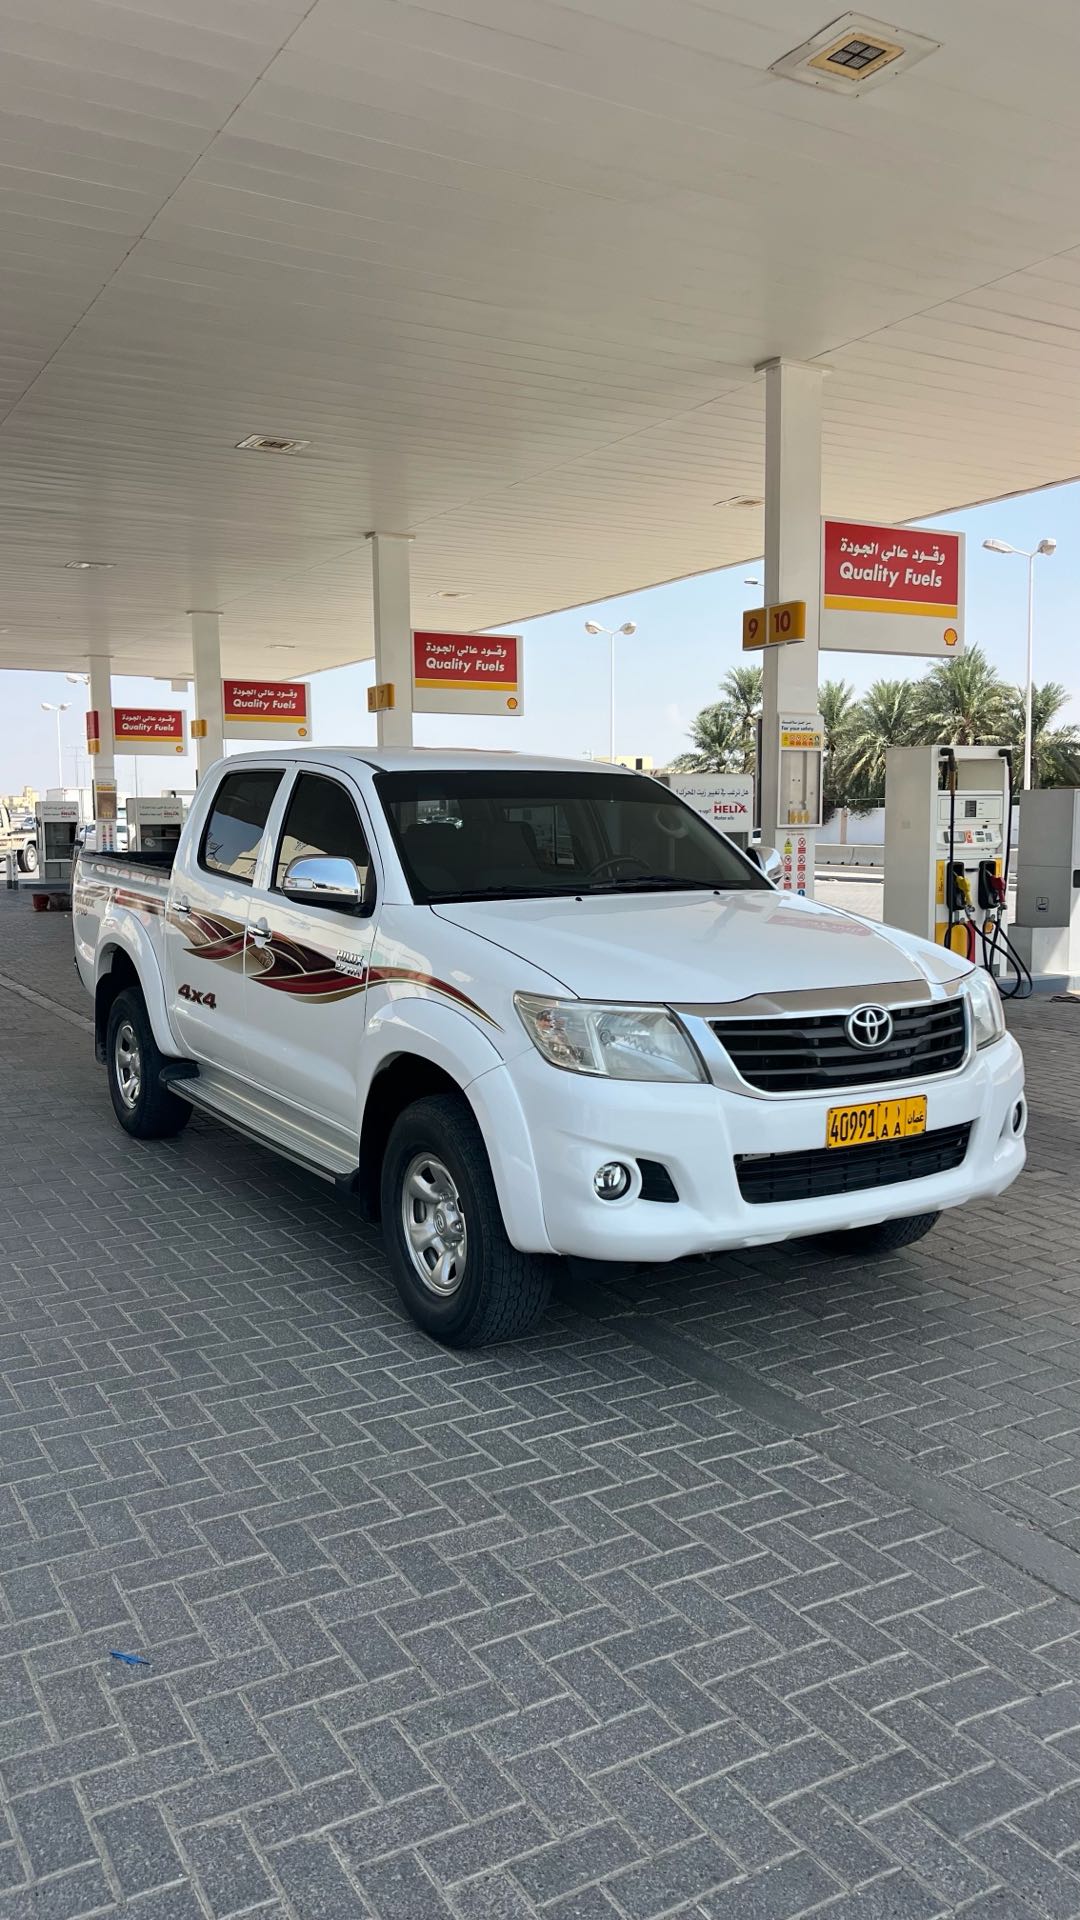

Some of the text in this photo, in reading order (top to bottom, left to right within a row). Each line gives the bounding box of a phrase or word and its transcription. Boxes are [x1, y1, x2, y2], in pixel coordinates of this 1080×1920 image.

[840, 537, 879, 558] الجودة
[881, 544, 908, 562] عالي
[839, 561, 942, 588] Quality Fuels
[748, 610, 791, 639] 9 10
[426, 642, 455, 654] الجودة
[425, 657, 505, 673] Quality Fuels
[232, 698, 296, 710] Quality Fuels
[121, 723, 174, 733] Quality Fuels
[713, 803, 748, 814] HELIX
[336, 949, 364, 967] HILUX
[178, 983, 217, 1010] 4x4
[830, 1108, 875, 1142] 40991
